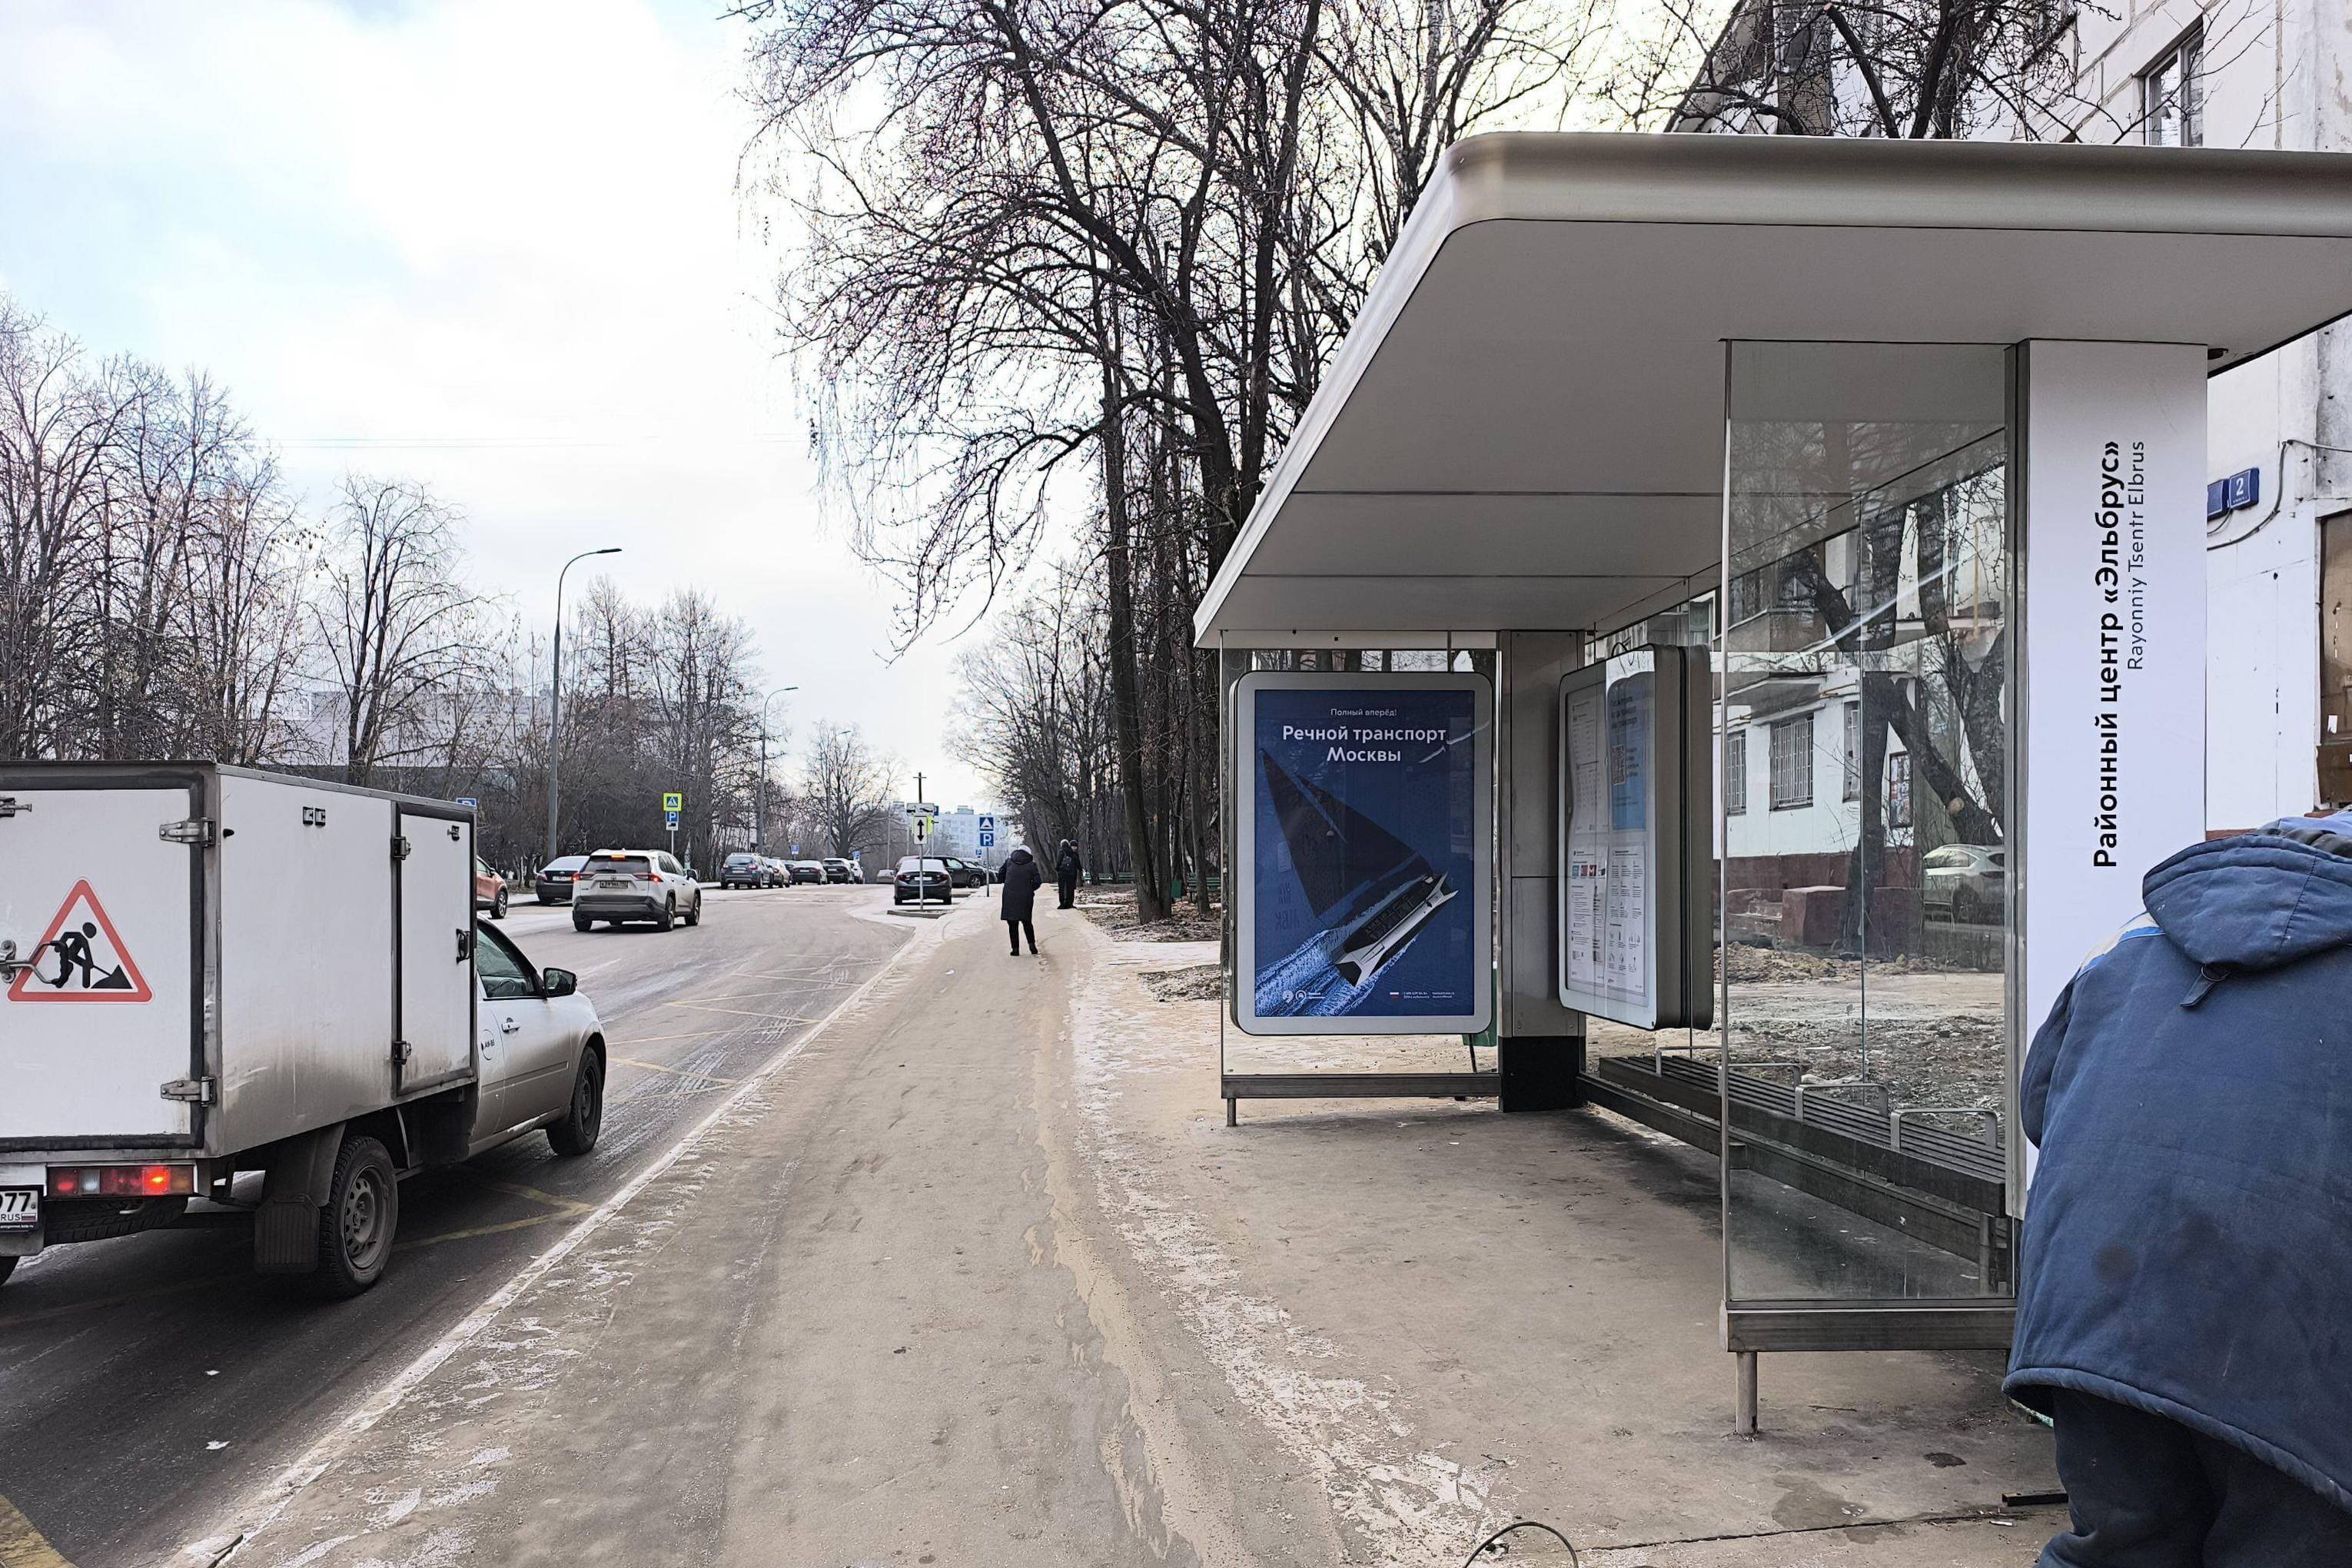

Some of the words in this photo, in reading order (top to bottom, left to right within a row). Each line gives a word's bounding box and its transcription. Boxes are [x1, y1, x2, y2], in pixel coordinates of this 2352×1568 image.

[2128, 441, 2144, 505] Elbrus
[2236, 477, 2244, 497] 2
[2095, 441, 2124, 603] «Эльбрус»
[2128, 510, 2144, 572] Tsentr
[2128, 577, 2147, 669] Rayonniy
[2101, 613, 2124, 702] центр
[1283, 725, 1348, 740] Речной
[1353, 729, 1447, 743] транспорт
[1330, 708, 1364, 716] Полный
[1365, 708, 1397, 718] вперёд!
[1327, 746, 1401, 762] Москвы
[2094, 713, 2118, 867] Районный
[1, 1213, 21, 1221] RUS
